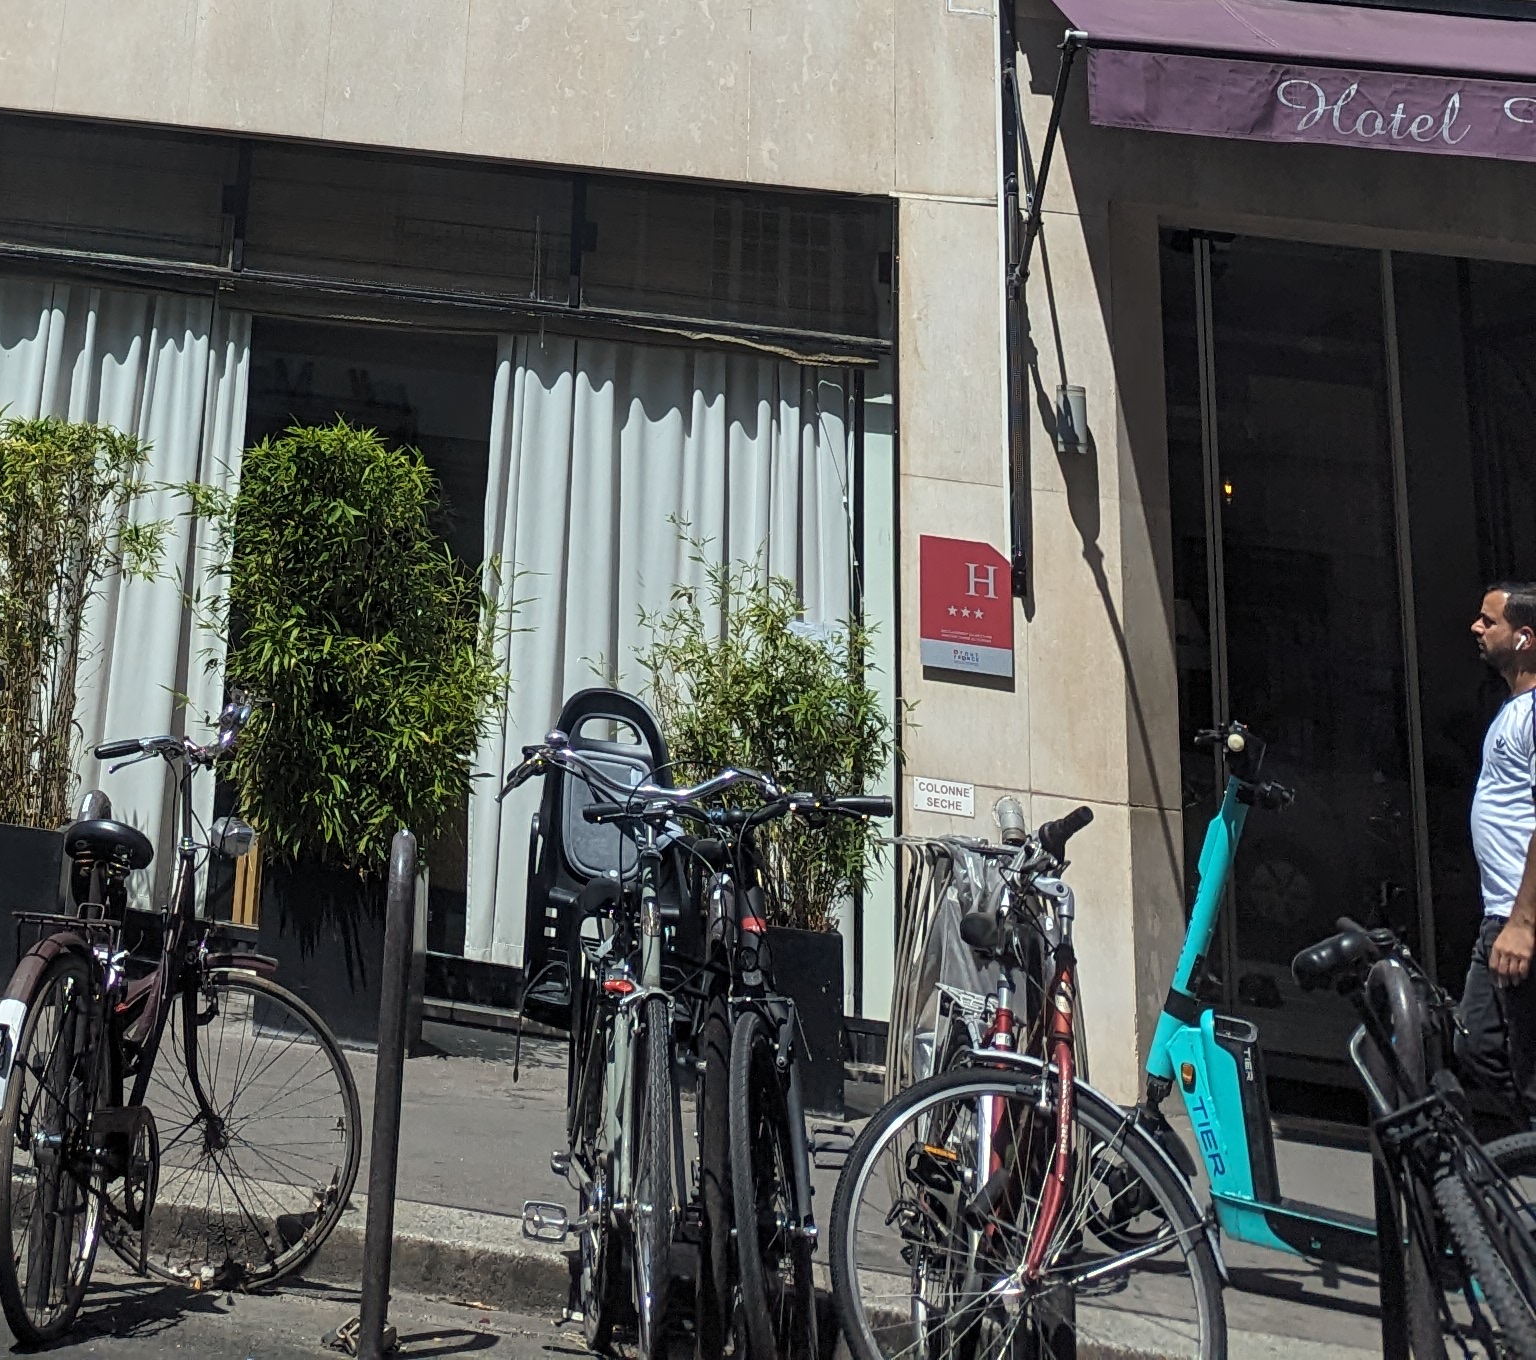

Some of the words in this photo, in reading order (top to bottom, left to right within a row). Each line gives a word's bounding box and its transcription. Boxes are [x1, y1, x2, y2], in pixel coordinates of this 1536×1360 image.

[1276, 79, 1472, 145] Hotel
[964, 562, 999, 599] H
[918, 781, 970, 798] COLONNE
[926, 796, 963, 812] SECHE
[1243, 1046, 1254, 1082] TIER
[1192, 1095, 1226, 1178] TIER
